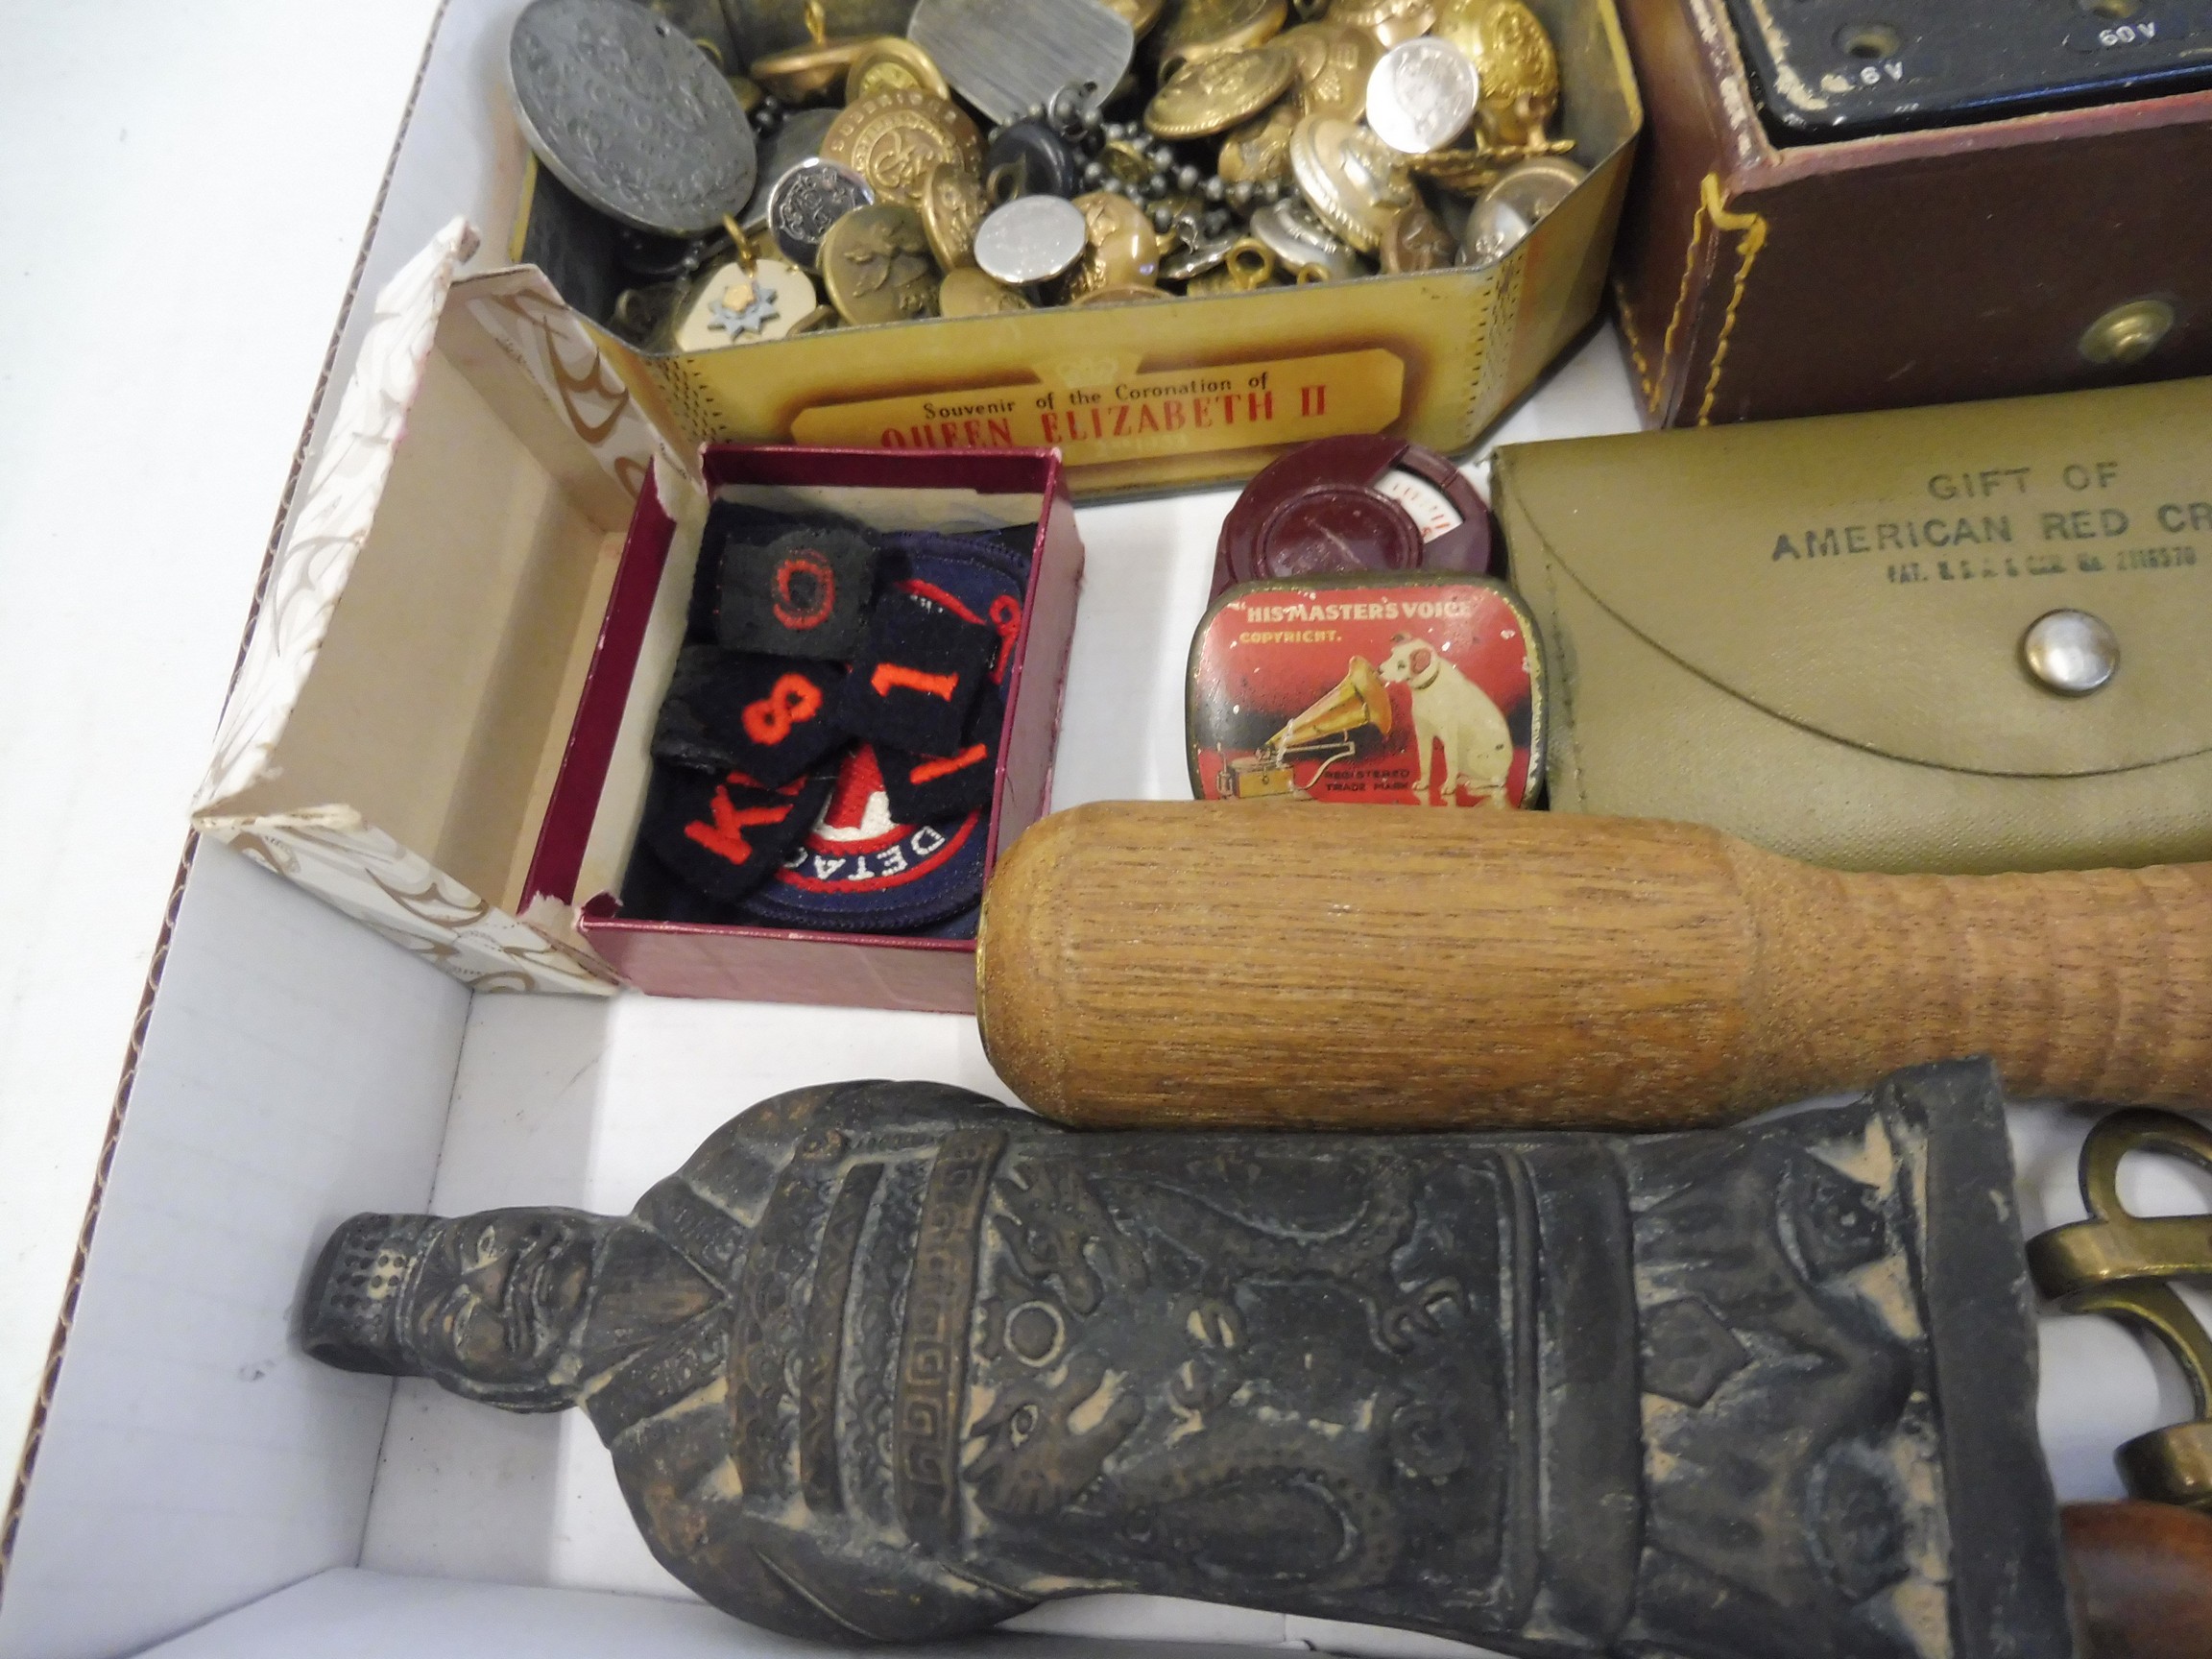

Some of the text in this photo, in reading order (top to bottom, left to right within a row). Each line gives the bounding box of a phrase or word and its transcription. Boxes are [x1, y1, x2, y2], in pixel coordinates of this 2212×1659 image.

[924, 372, 1269, 421] Souvenir of the Coronation of
[1041, 389, 1274, 445] ELIZABETH
[1301, 384, 1327, 419] II
[1927, 461, 2119, 501] GIFT OF
[1771, 515, 2014, 563] AMERICAN
[2040, 507, 2130, 541] RED
